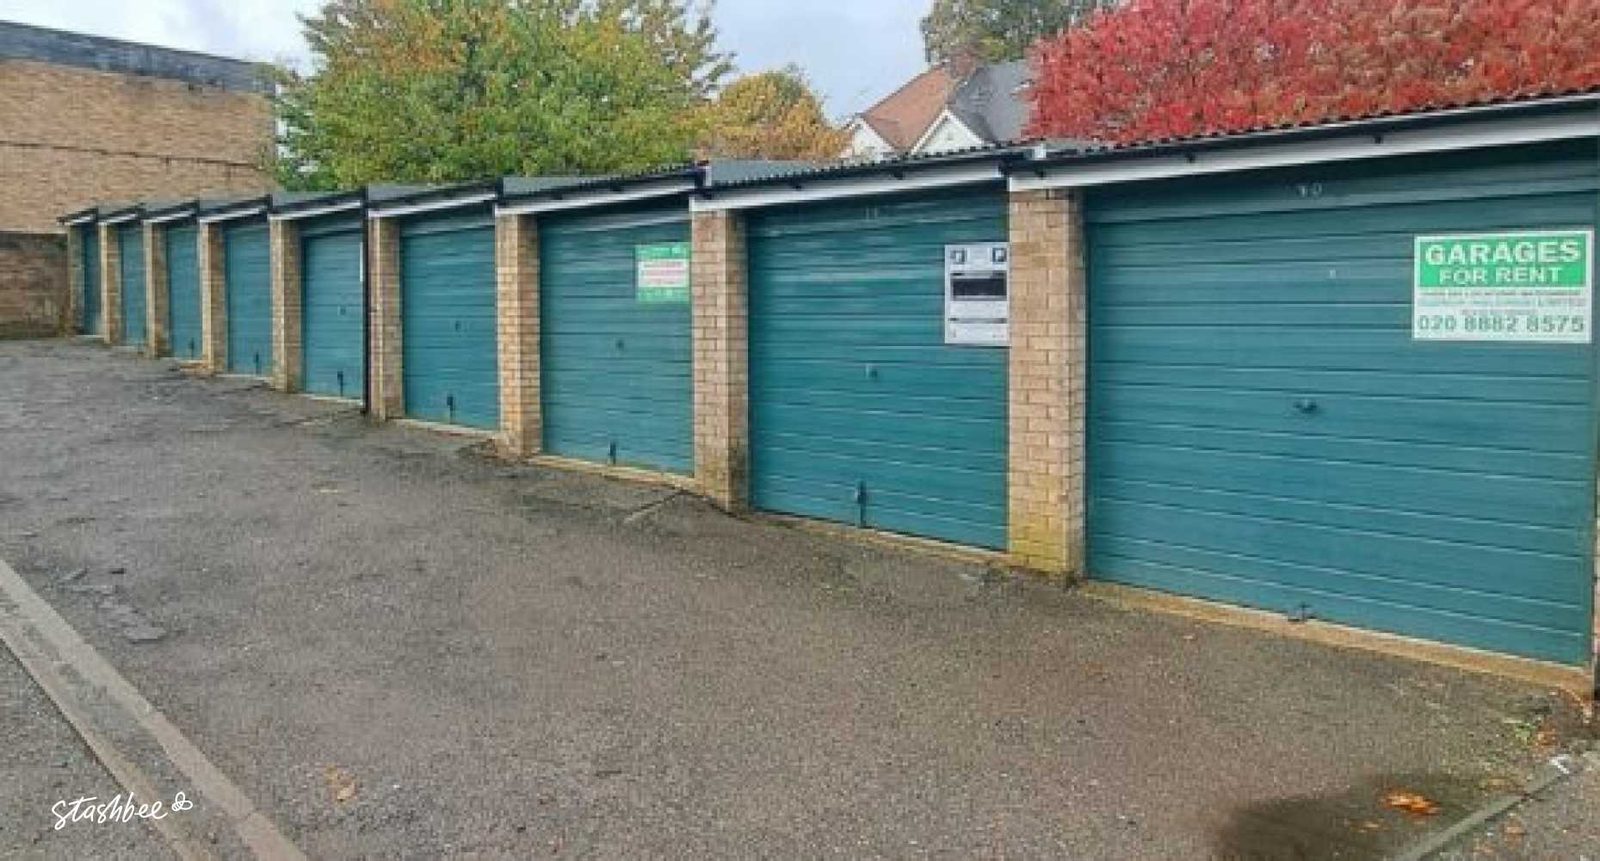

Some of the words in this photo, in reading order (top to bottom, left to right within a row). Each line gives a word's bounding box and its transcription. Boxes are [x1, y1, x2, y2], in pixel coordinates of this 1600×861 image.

[1425, 240, 1580, 265] GARAGES
[1439, 268, 1488, 284] FOR
[1495, 267, 1562, 282] RENT
[1419, 314, 1457, 331] 020
